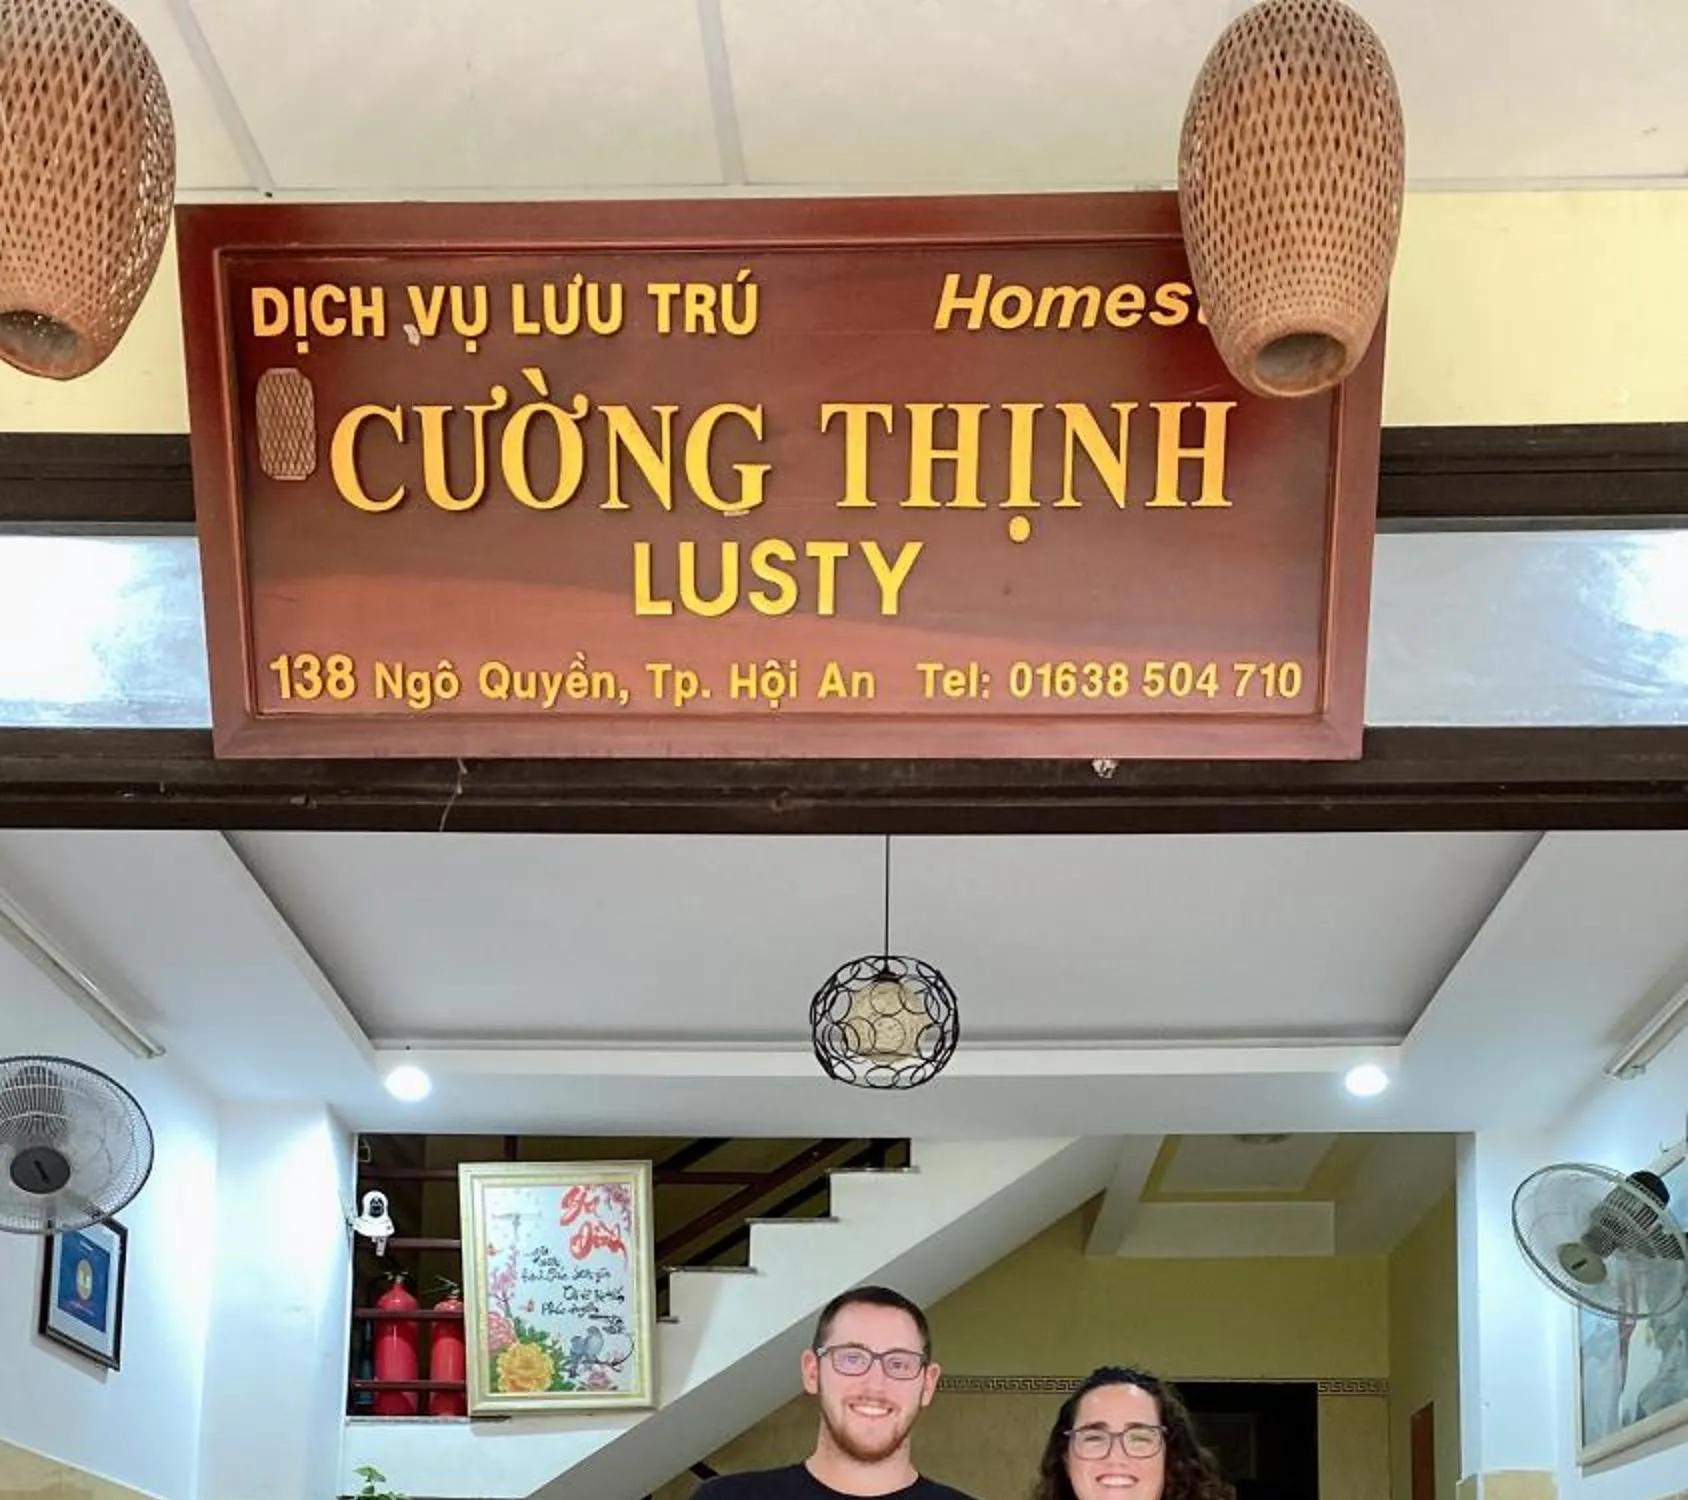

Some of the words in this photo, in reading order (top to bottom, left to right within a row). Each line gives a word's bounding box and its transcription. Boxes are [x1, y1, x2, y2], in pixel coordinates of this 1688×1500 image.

[252, 286, 385, 354] DỊCH
[409, 285, 487, 352] VỤ
[511, 273, 623, 335] LƯU
[648, 269, 759, 336] TRÚ
[934, 273, 1208, 330] Homes
[330, 368, 772, 512] CƯỜNG
[821, 401, 1237, 543] THỊNH
[634, 539, 924, 617] LUSTY
[270, 653, 356, 702] 138
[373, 661, 460, 709] Ngô
[479, 659, 630, 709] Quyền,
[645, 660, 711, 709] Tp.
[730, 660, 799, 709] Hội
[817, 659, 876, 701] An
[917, 660, 991, 700] Tel:
[1007, 658, 1131, 701] 01638
[1141, 660, 1220, 701] 504
[1235, 660, 1303, 700] 710
